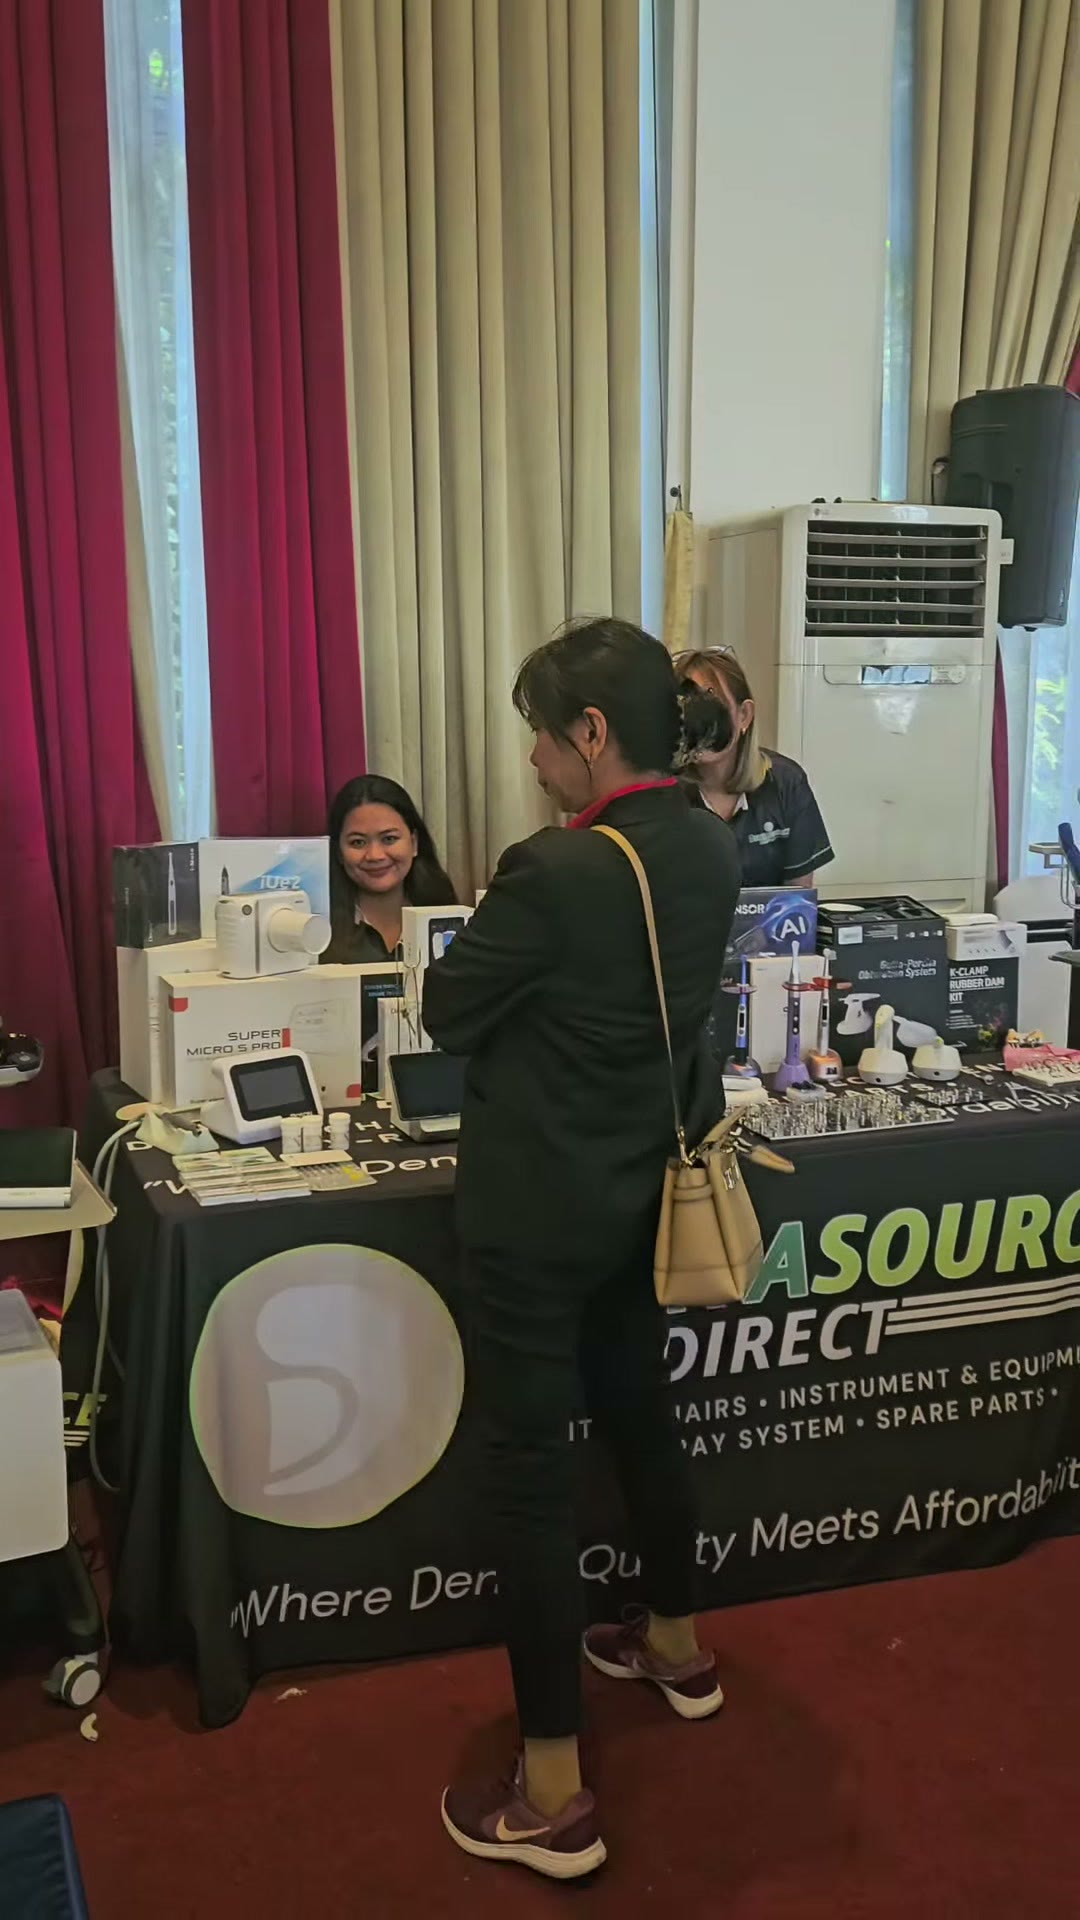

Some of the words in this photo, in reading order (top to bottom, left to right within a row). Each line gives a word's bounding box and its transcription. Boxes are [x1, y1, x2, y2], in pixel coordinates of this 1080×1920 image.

[732, 903, 766, 915] NSOR
[780, 916, 806, 939] AI
[950, 965, 989, 978] K-CLAMP
[949, 979, 984, 990] RUBBER
[985, 977, 1006, 989] DAM
[949, 992, 964, 1003] KIT
[228, 1029, 281, 1041] SUPER
[186, 1045, 233, 1056] MICRO
[237, 1044, 248, 1053] S
[252, 1041, 281, 1051] PRO
[360, 1154, 458, 1176] Den
[742, 1189, 1080, 1304] ASOURC
[663, 1299, 898, 1383] DIRECT
[568, 1418, 593, 1442] IT
[675, 1396, 747, 1424] AIRS
[780, 1368, 950, 1410] INSTRUMENT
[960, 1364, 978, 1385] &
[681, 1433, 725, 1457] AY
[739, 1415, 844, 1449] SYSTEM
[877, 1400, 959, 1430] SPARE
[970, 1388, 1044, 1417] PARTS
[410, 1566, 498, 1611] Den
[750, 1507, 880, 1557] Meets
